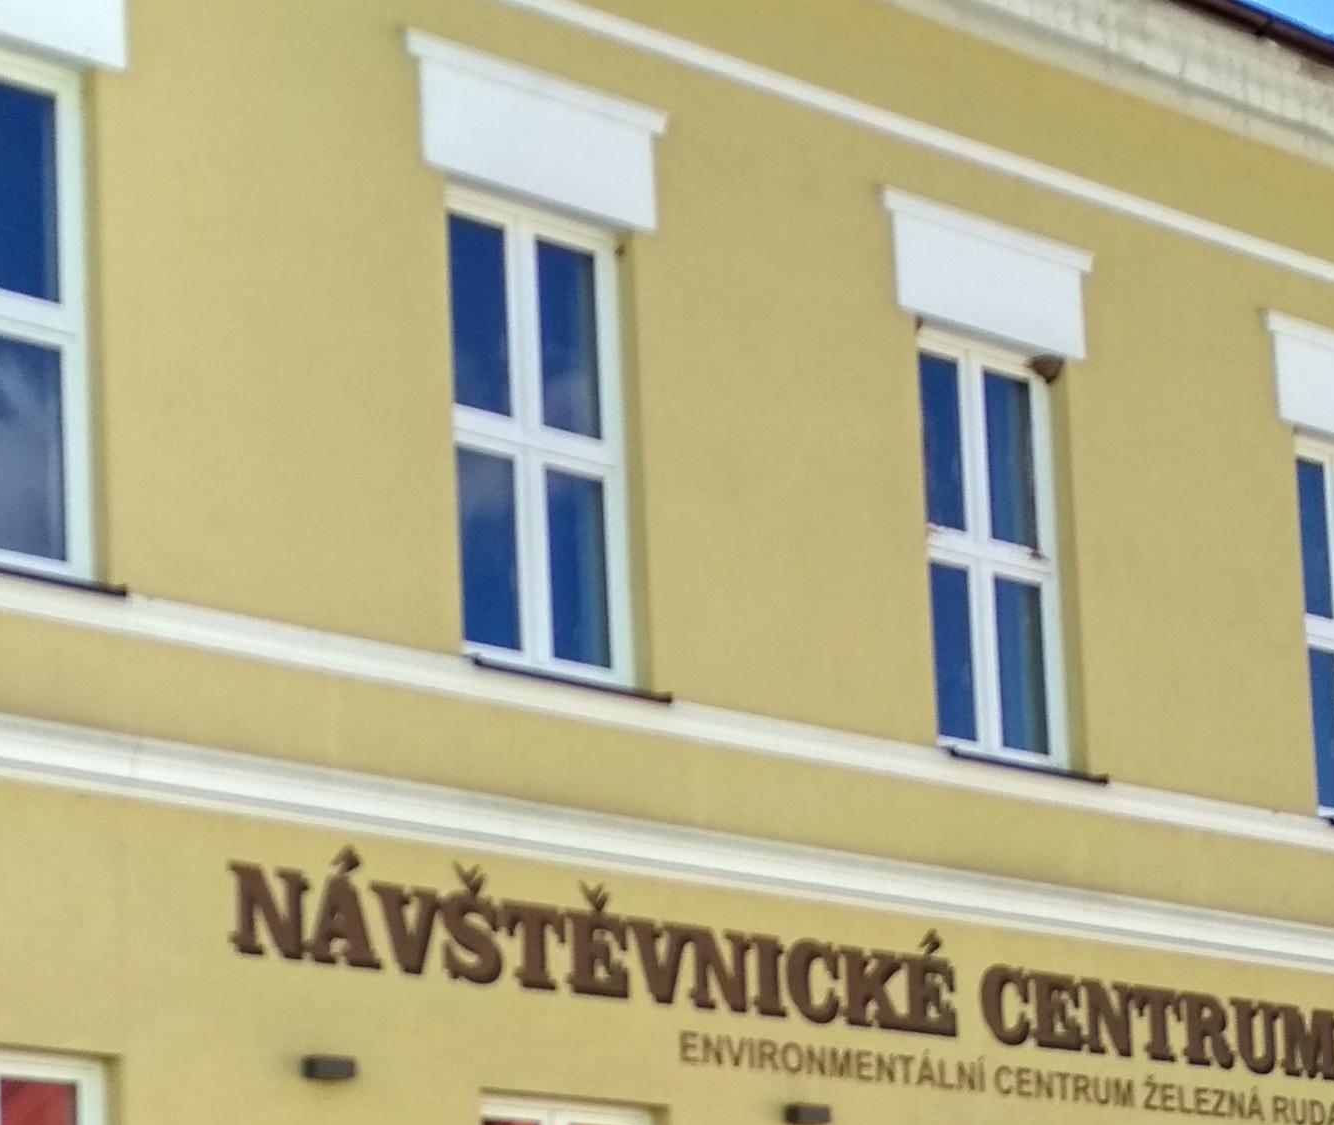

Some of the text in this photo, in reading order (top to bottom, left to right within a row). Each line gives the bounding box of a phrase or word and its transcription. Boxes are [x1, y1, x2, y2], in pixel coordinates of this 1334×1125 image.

[228, 845, 958, 1037] NÁVŠTĚVNICKÉ
[678, 1030, 986, 1092] ENVIRONMENTÁLNÍ
[994, 1063, 1135, 1108] CENTRUM
[1142, 1073, 1266, 1122] ŽELEZNÁ
